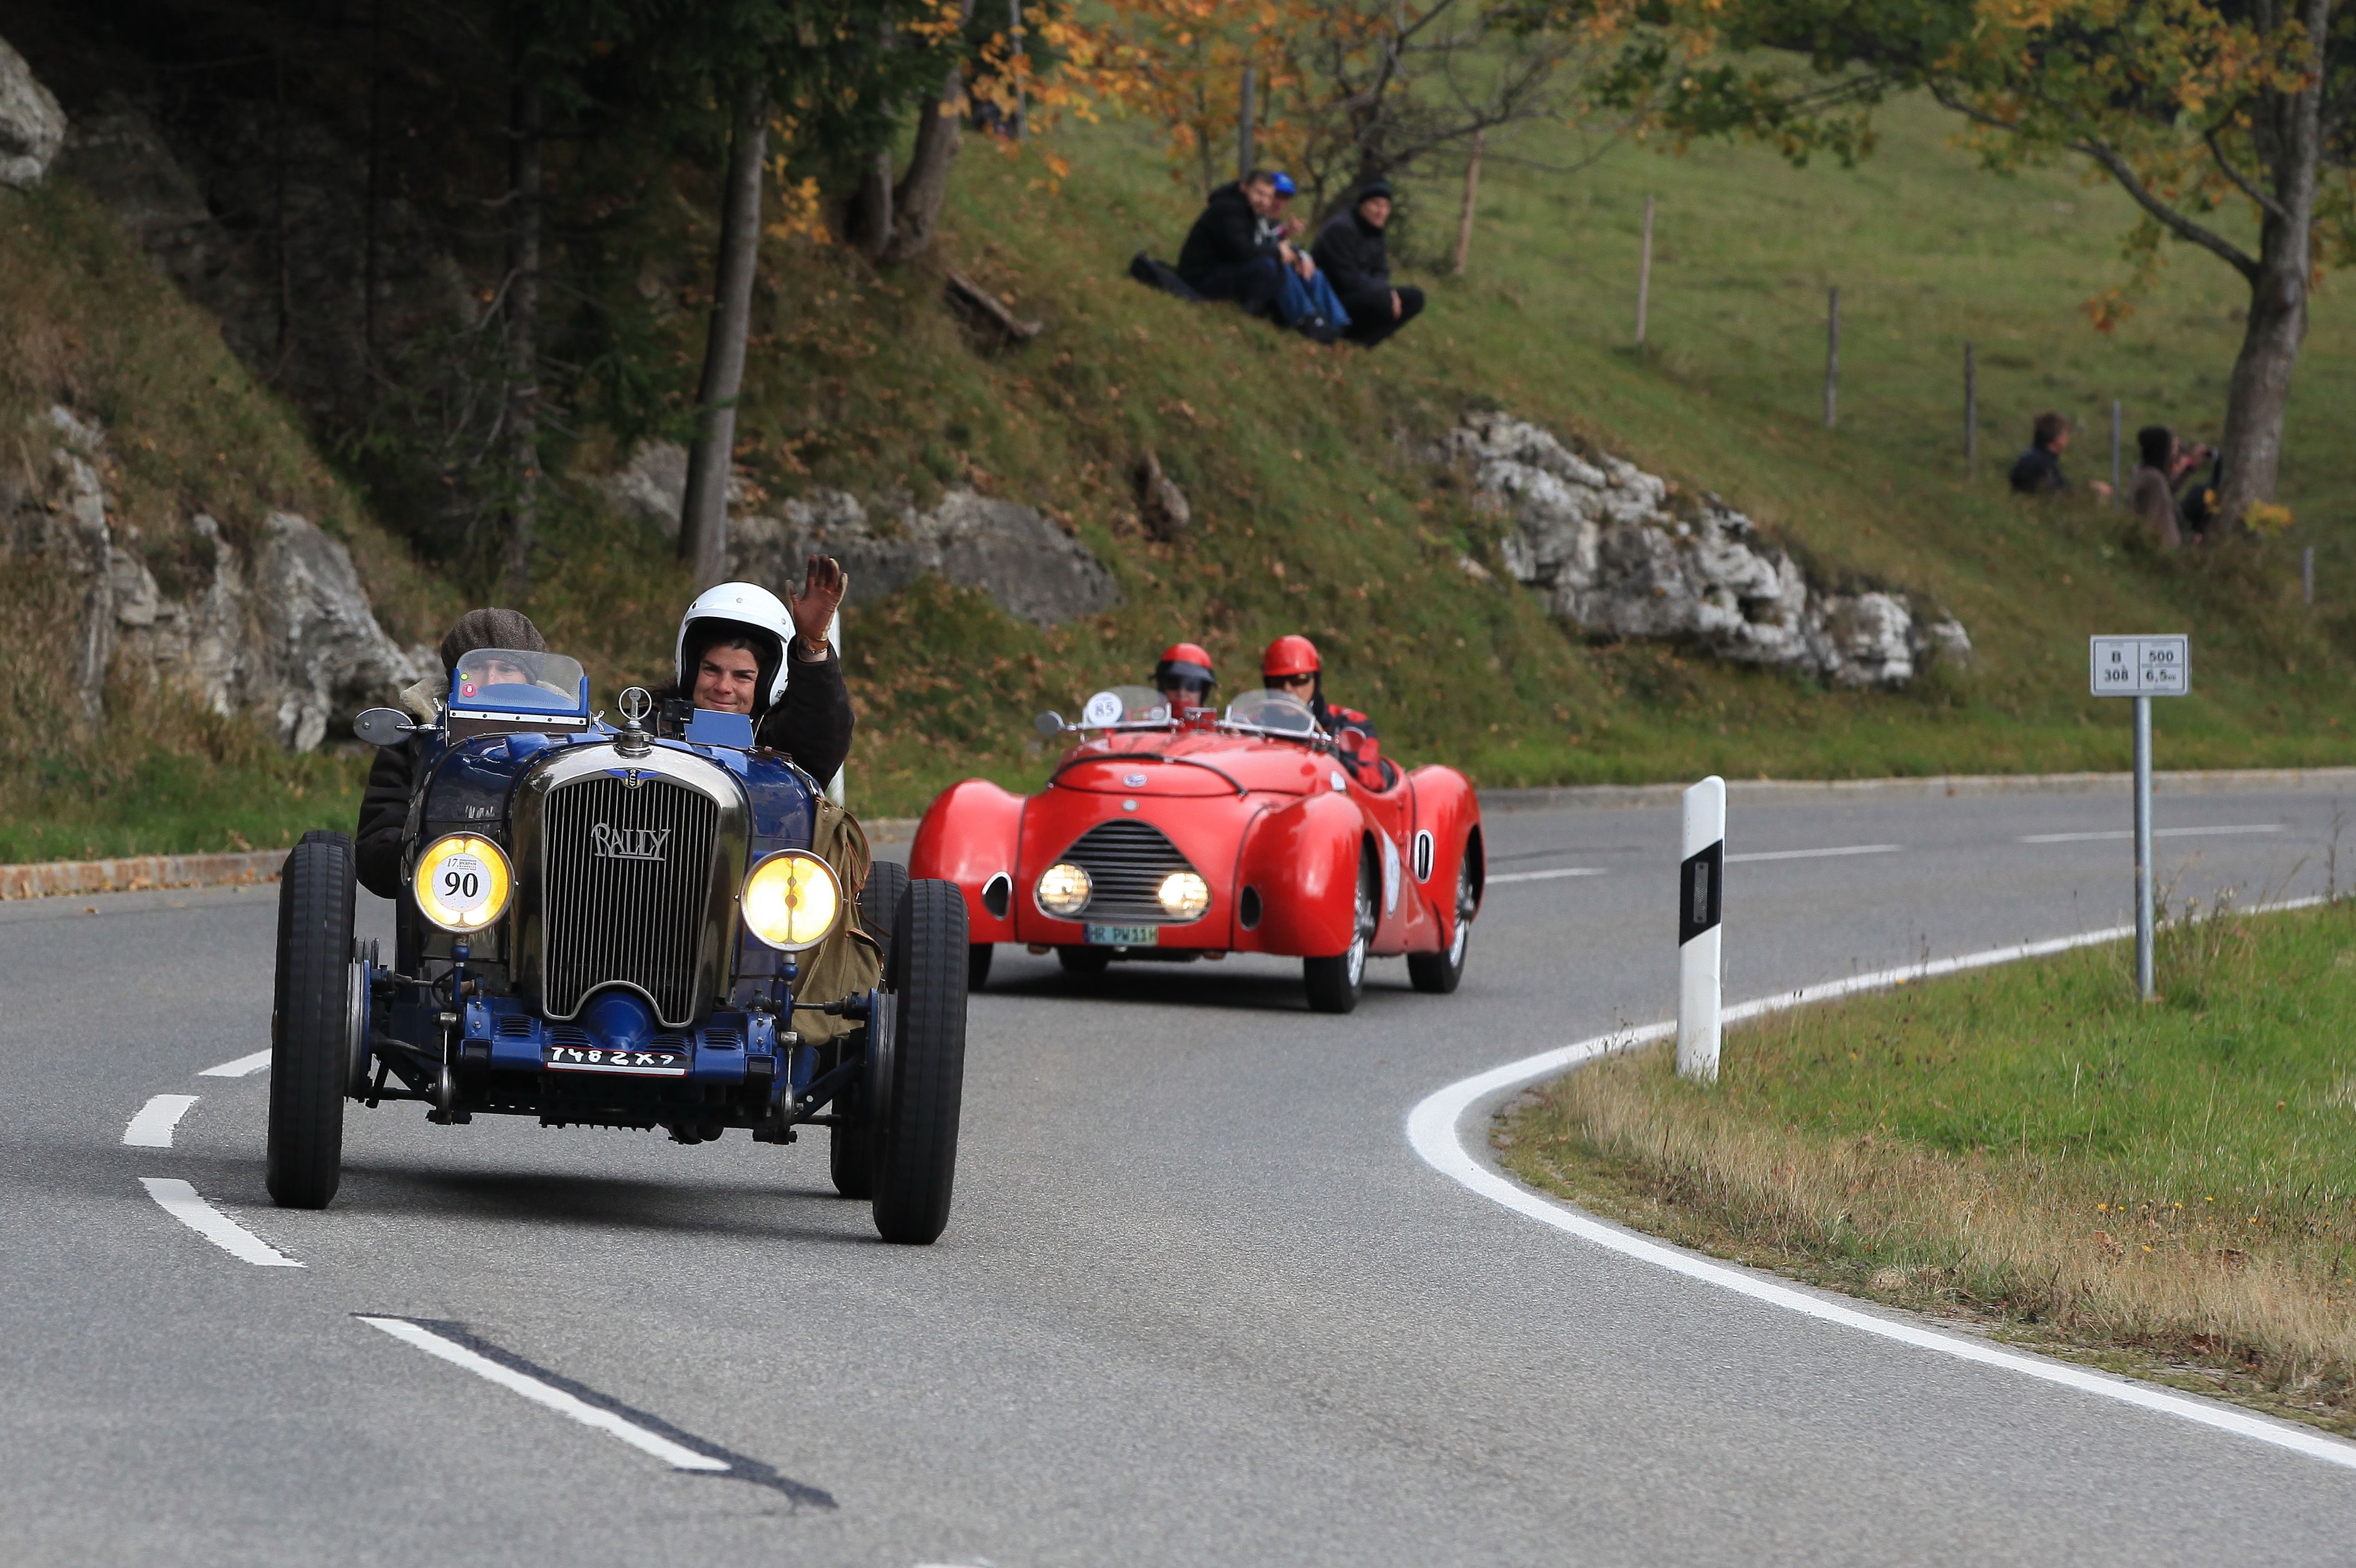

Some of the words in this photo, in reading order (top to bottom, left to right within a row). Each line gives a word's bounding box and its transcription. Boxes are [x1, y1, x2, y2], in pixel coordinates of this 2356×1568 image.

[2111, 650, 2121, 663] B
[2149, 650, 2174, 663] 500
[2104, 669, 2129, 683] 308
[591, 823, 671, 861] RALLY
[445, 872, 479, 898] 90
